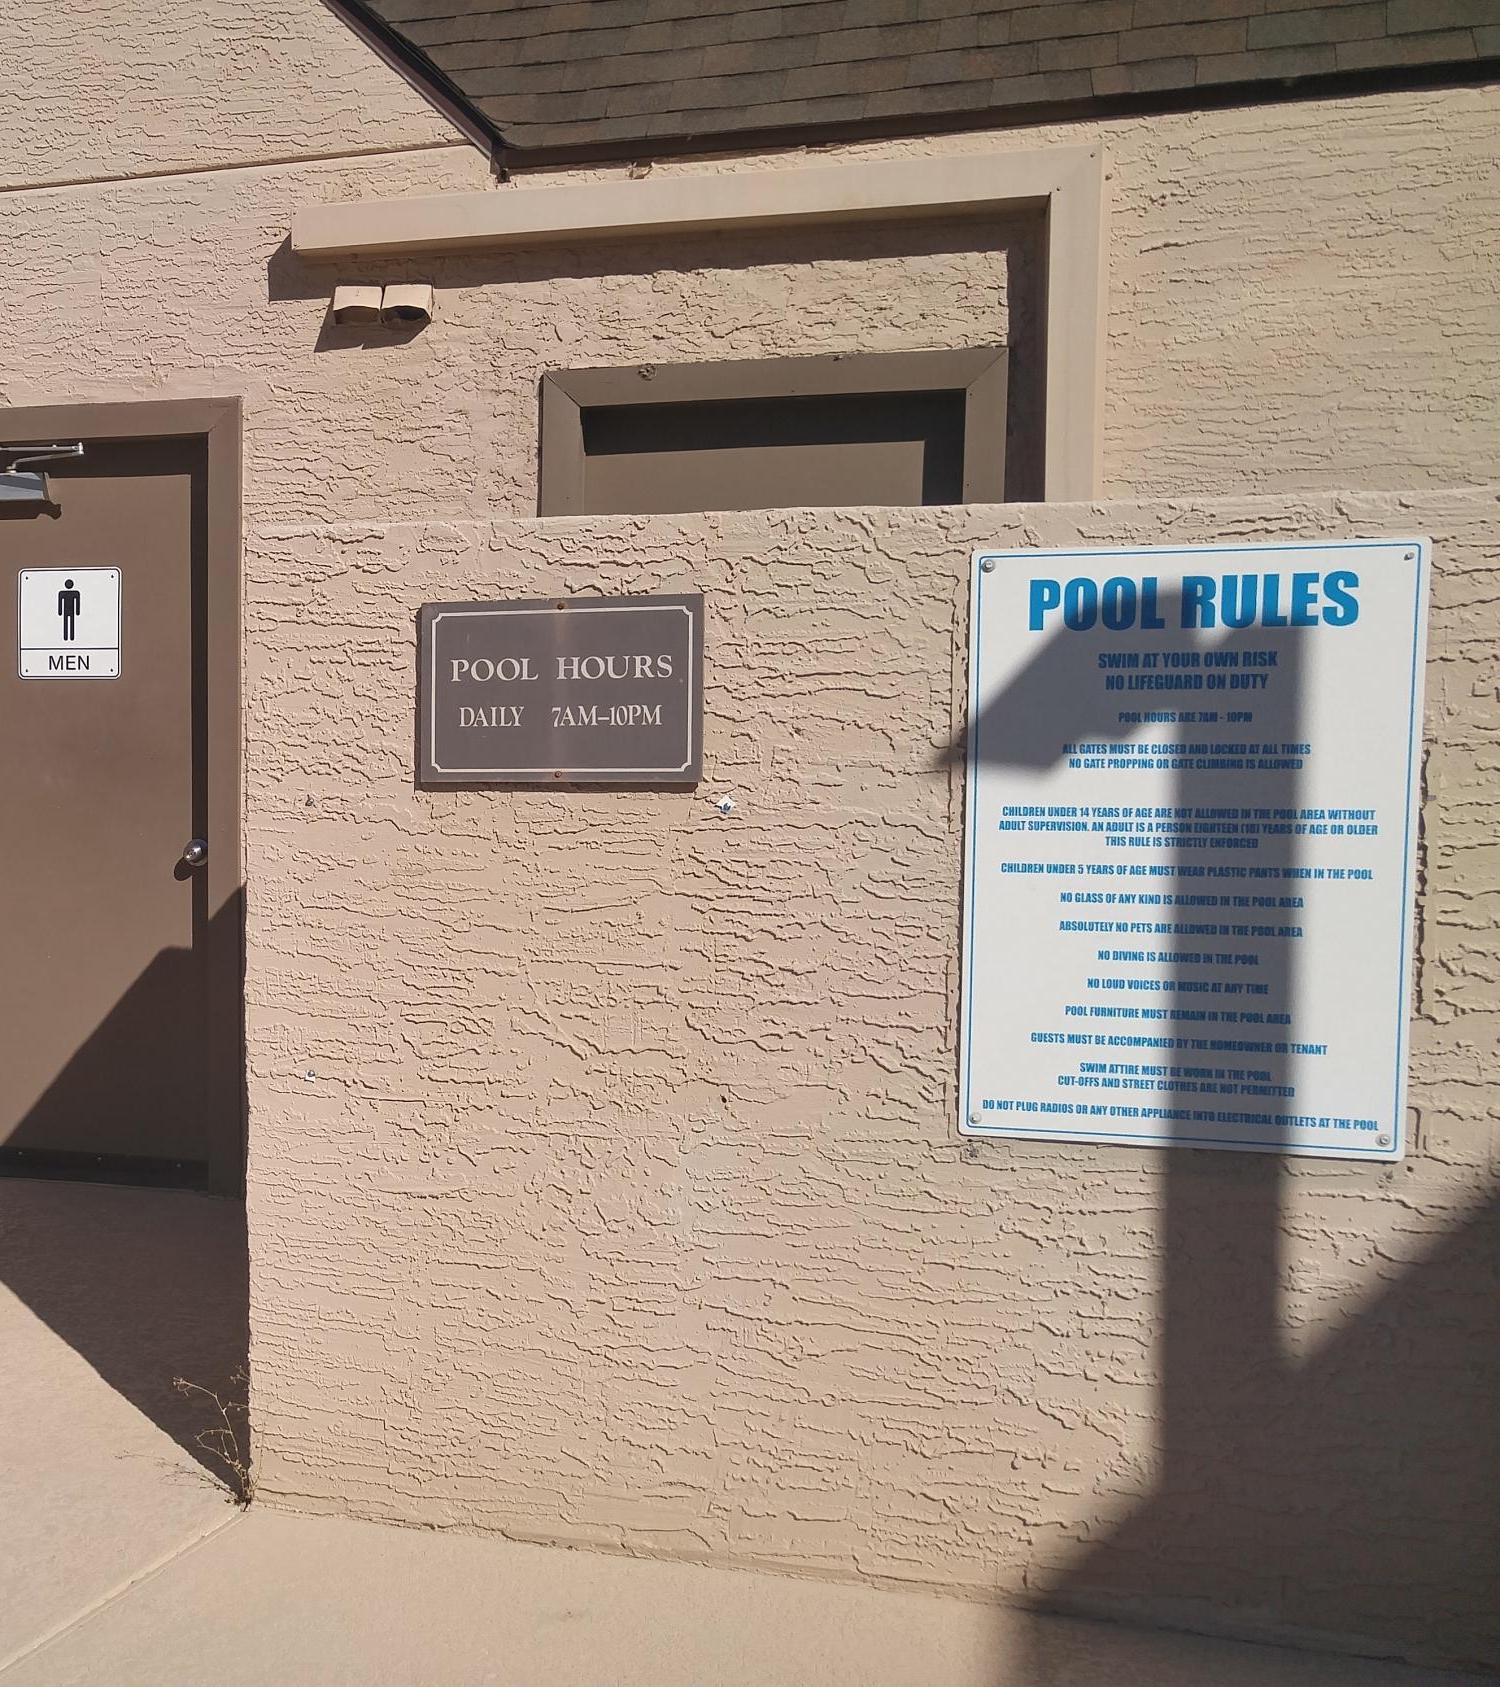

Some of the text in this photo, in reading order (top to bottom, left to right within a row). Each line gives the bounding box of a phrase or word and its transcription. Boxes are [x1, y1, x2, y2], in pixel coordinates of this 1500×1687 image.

[1029, 570, 1360, 631] POOL RULES
[49, 655, 90, 671] MEN
[450, 654, 673, 683] POOL HOURS
[1098, 650, 1277, 670] SWIM AT YOUR OWN RISK
[1106, 673, 1268, 691] NO LIFEGUARD ON DUTY
[459, 706, 525, 728] DAILY
[1118, 711, 1252, 722] POOL HOURS ARE 7AM 10PM
[1063, 743, 1311, 754] ALL GATES MUST BE CLOSED AND LOCKED ALL TIMES
[1069, 758, 1303, 769] NO GATE PROPPING OR GATE CLIMBING ALLOWED
[1002, 806, 1375, 820] CHILDREN UNDER 14 YEARS OF AGE ARE NOT ALLOWED POOL AREA WITHOUT
[999, 820, 1378, 835] ADULT SUPERVISION. AN ADULT IS A PERSON EIGHTEEN YEARS OF AGE OR OLDER
[1105, 835, 1258, 848] THIS RULE IS STRICTLY ENFORCED
[1001, 862, 1373, 880] CHILDREN UNDER 5 YEARS OF AGE MUST WEAR PLASTIC PANTS WHEN IN THE POOL
[1060, 892, 1304, 908] NO GLASS OF ANY KIND IS ALLOWED POOL AREA
[1059, 921, 1302, 937] ABSOLUTELY NO PETS ARE ALLOWED POOL AREA
[1098, 950, 1259, 964] NO DIVING IS ALLOWED POOL
[1087, 978, 1268, 994] NO LOUD VOICES OR MUSIC ANY TIME
[1065, 1005, 1291, 1024] POOL FURNITURE MUST REMAIN POOL AREA
[1030, 1032, 1327, 1055] GUESTS MUST BE ACCOMPANIED HOMEOWNER TENANT
[1080, 1062, 1271, 1080] SWIM ATTIRE MUST WORN POOL
[1058, 1076, 1295, 1096] CUT-OFFS AND STREET CLOTHES ARE NOT PERMITTED
[982, 1099, 1379, 1130] DO NOT PLUG RADIOS OR ANY OTHER APPLIANCE INTO ELECTRICAL OUTLETS AT THE POOL
